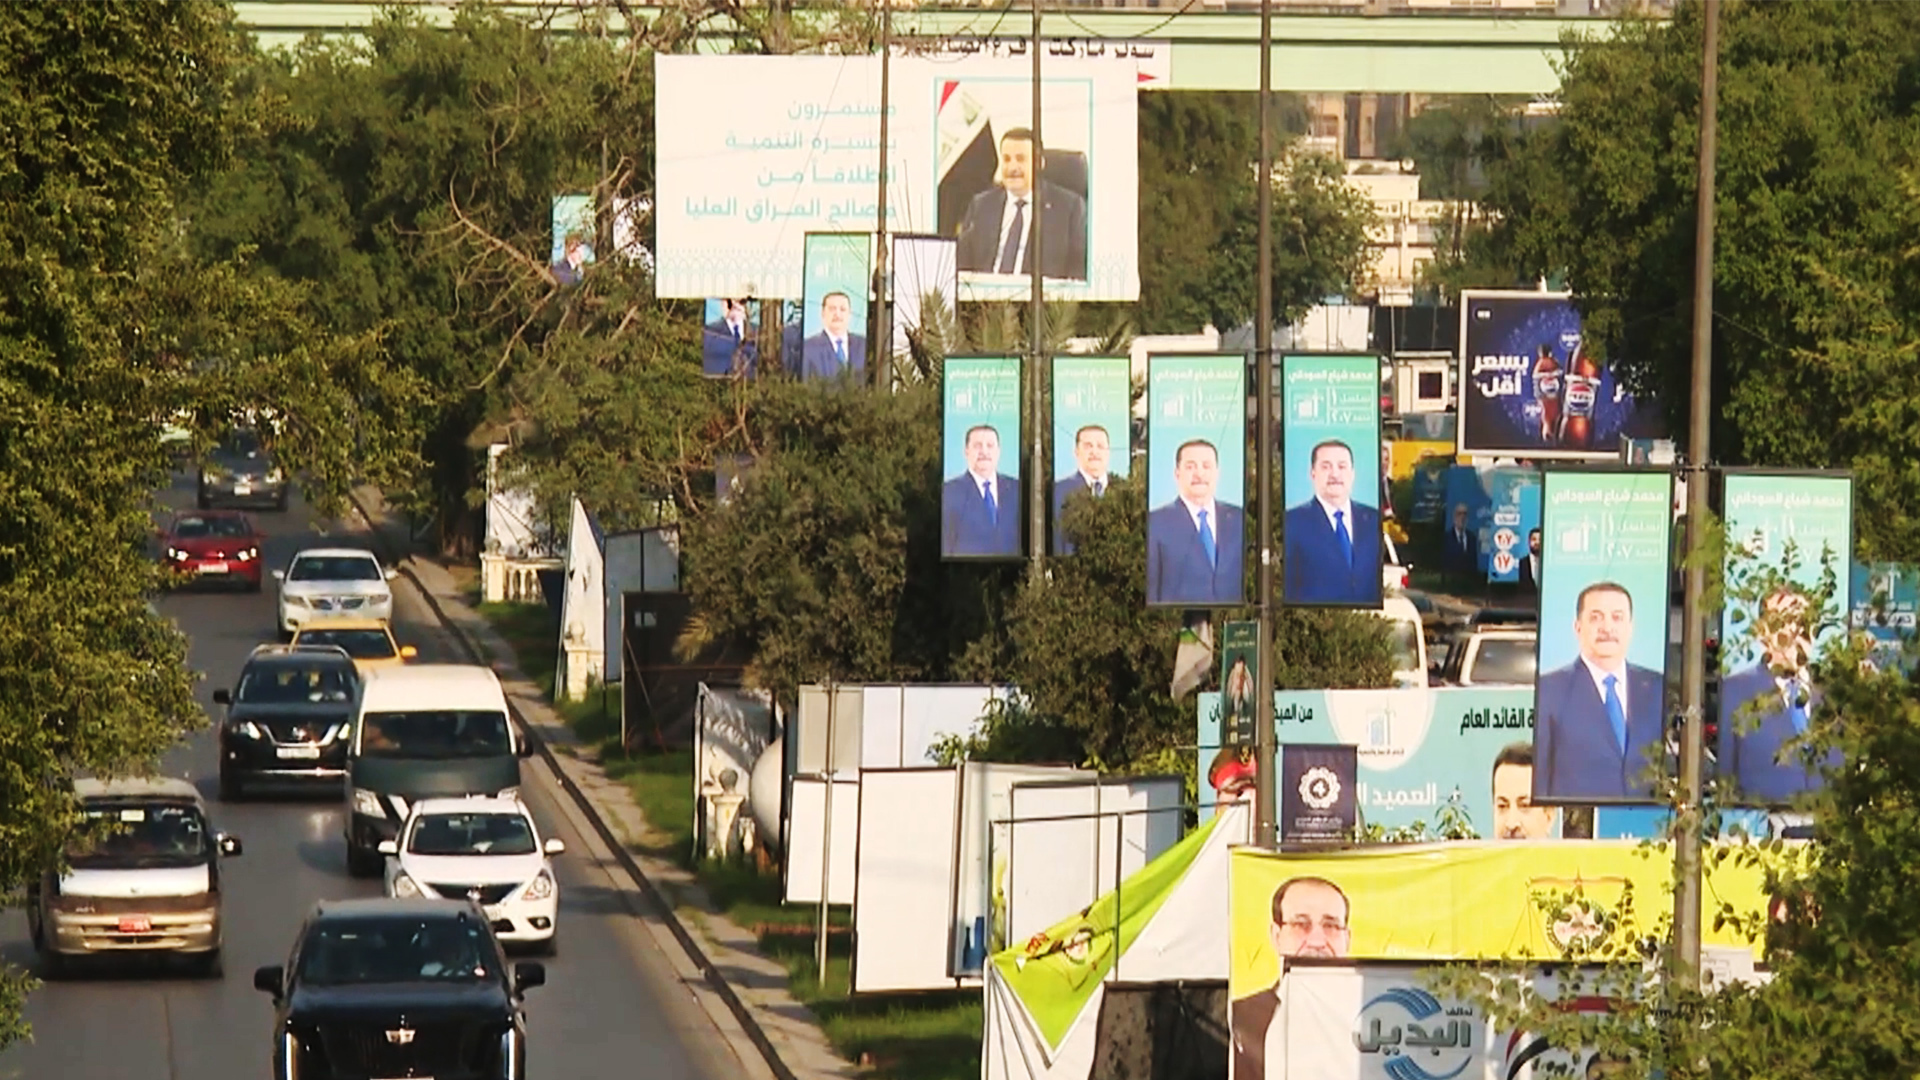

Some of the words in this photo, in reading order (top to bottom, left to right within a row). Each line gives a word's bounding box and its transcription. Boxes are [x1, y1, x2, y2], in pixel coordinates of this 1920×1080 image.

[725, 131, 803, 150] التنمية
[812, 134, 897, 154] بسيرة
[757, 166, 804, 187] من
[686, 196, 738, 220] العليا
[745, 198, 821, 223] العراق
[1472, 354, 1529, 376] بسعر
[1481, 369, 1522, 398] أقل
[1552, 489, 1603, 505] السوداني
[1603, 488, 1631, 507] شياع
[1631, 490, 1664, 502] محمد
[1274, 703, 1297, 725] الميد
[1298, 706, 1313, 723] من
[1460, 707, 1490, 736] العام
[1493, 707, 1525, 728] القائد
[1373, 781, 1437, 811] العميد
[1352, 1018, 1471, 1056] البديل
